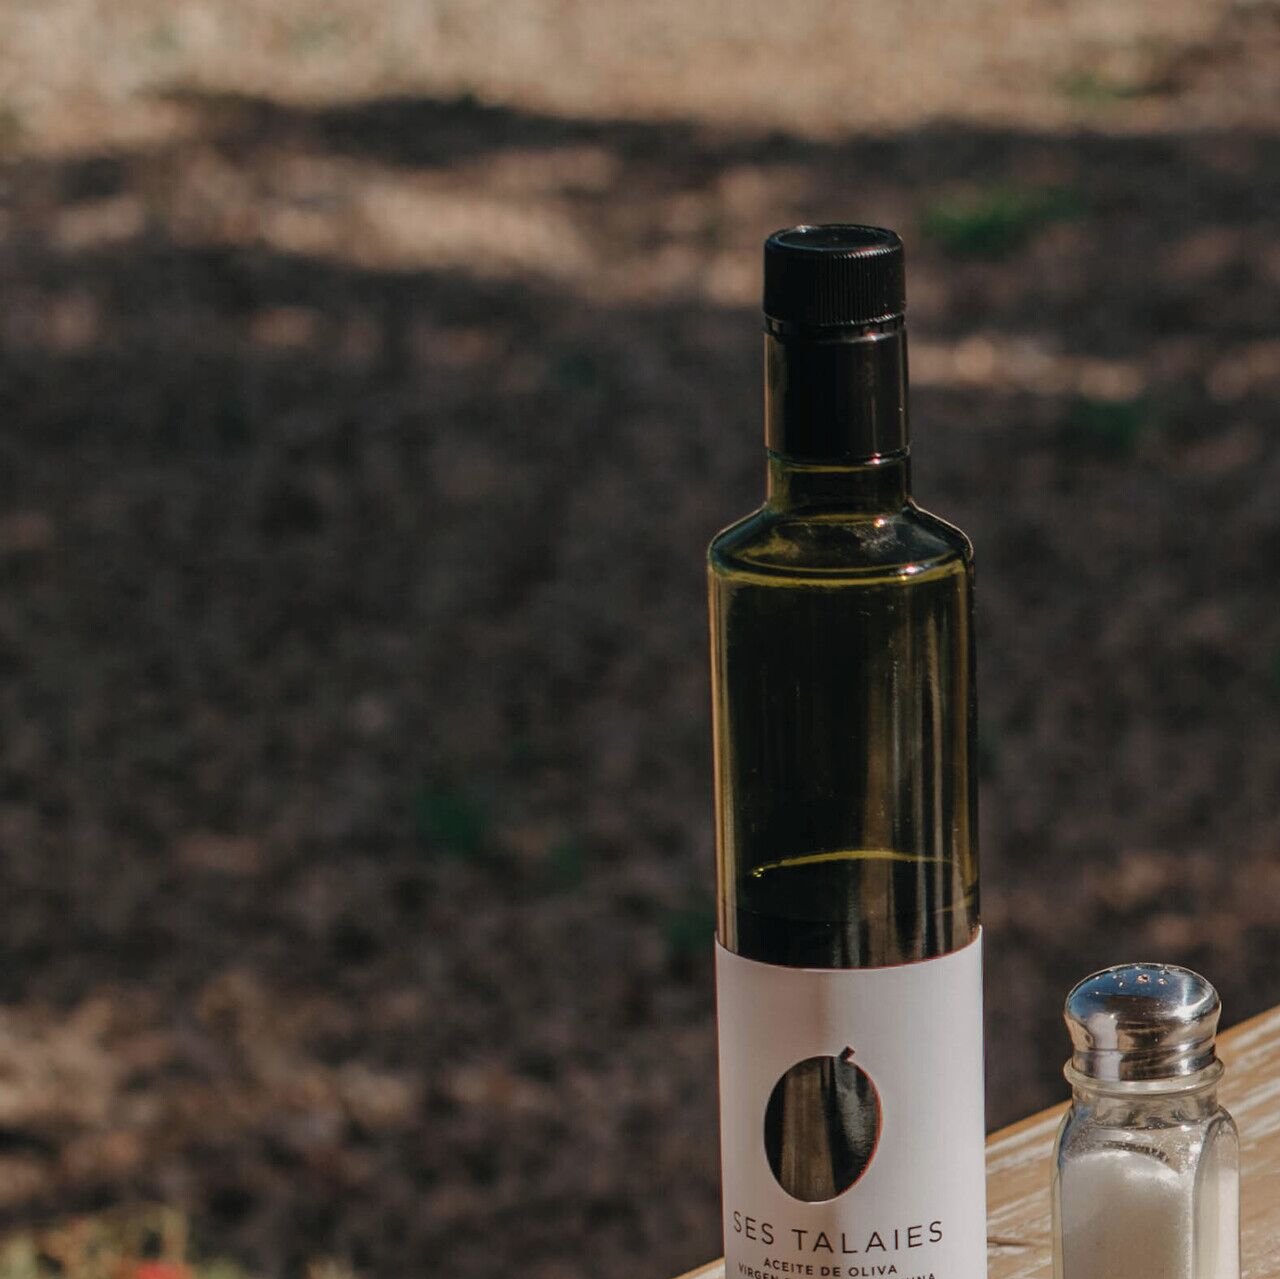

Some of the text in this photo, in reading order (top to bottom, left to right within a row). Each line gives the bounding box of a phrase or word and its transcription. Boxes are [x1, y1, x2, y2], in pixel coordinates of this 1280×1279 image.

[733, 1210, 943, 1254] SES TALAIES
[763, 1256, 898, 1278] ACEITE DE OLIVA
